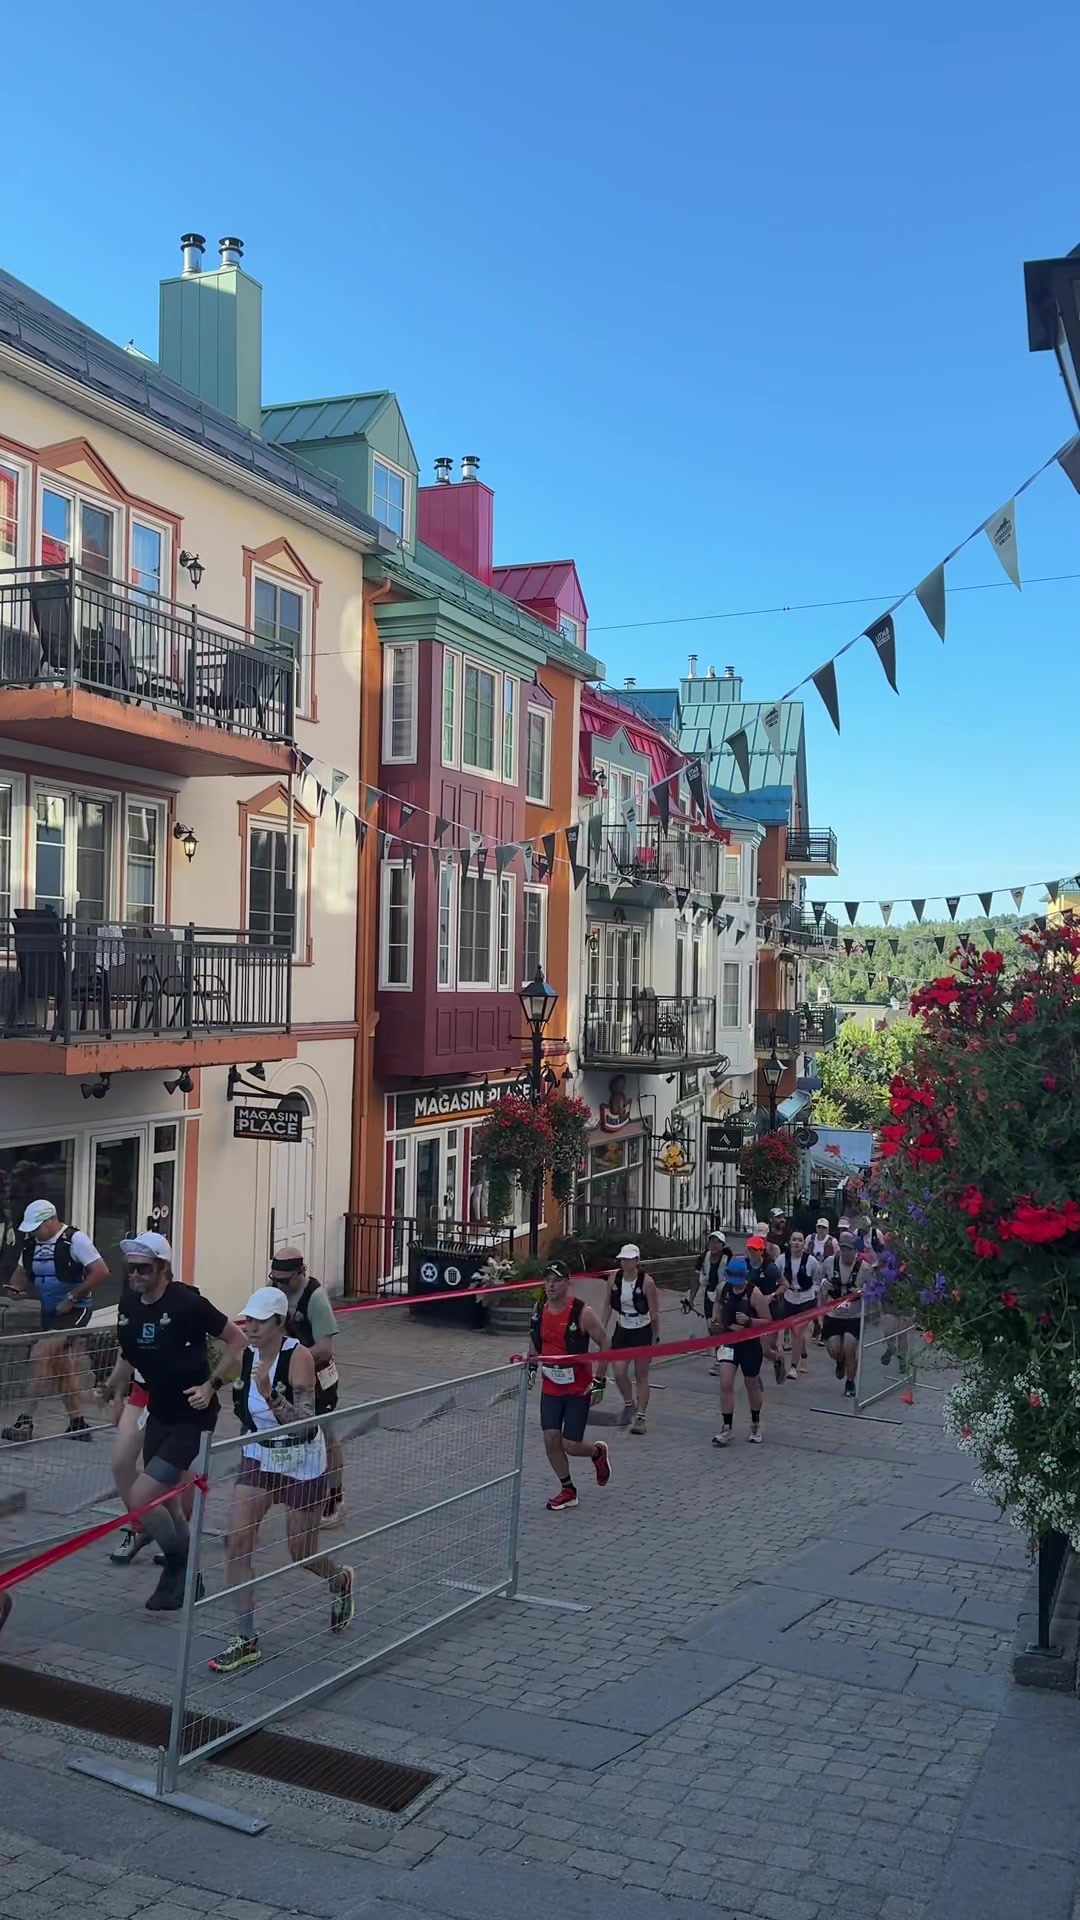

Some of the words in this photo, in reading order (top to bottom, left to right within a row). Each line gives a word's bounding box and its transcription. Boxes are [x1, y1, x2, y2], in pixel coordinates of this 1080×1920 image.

[415, 1089, 484, 1117] MAGASIN
[239, 1109, 298, 1122] MAGASIN
[239, 1119, 298, 1135] PLACE
